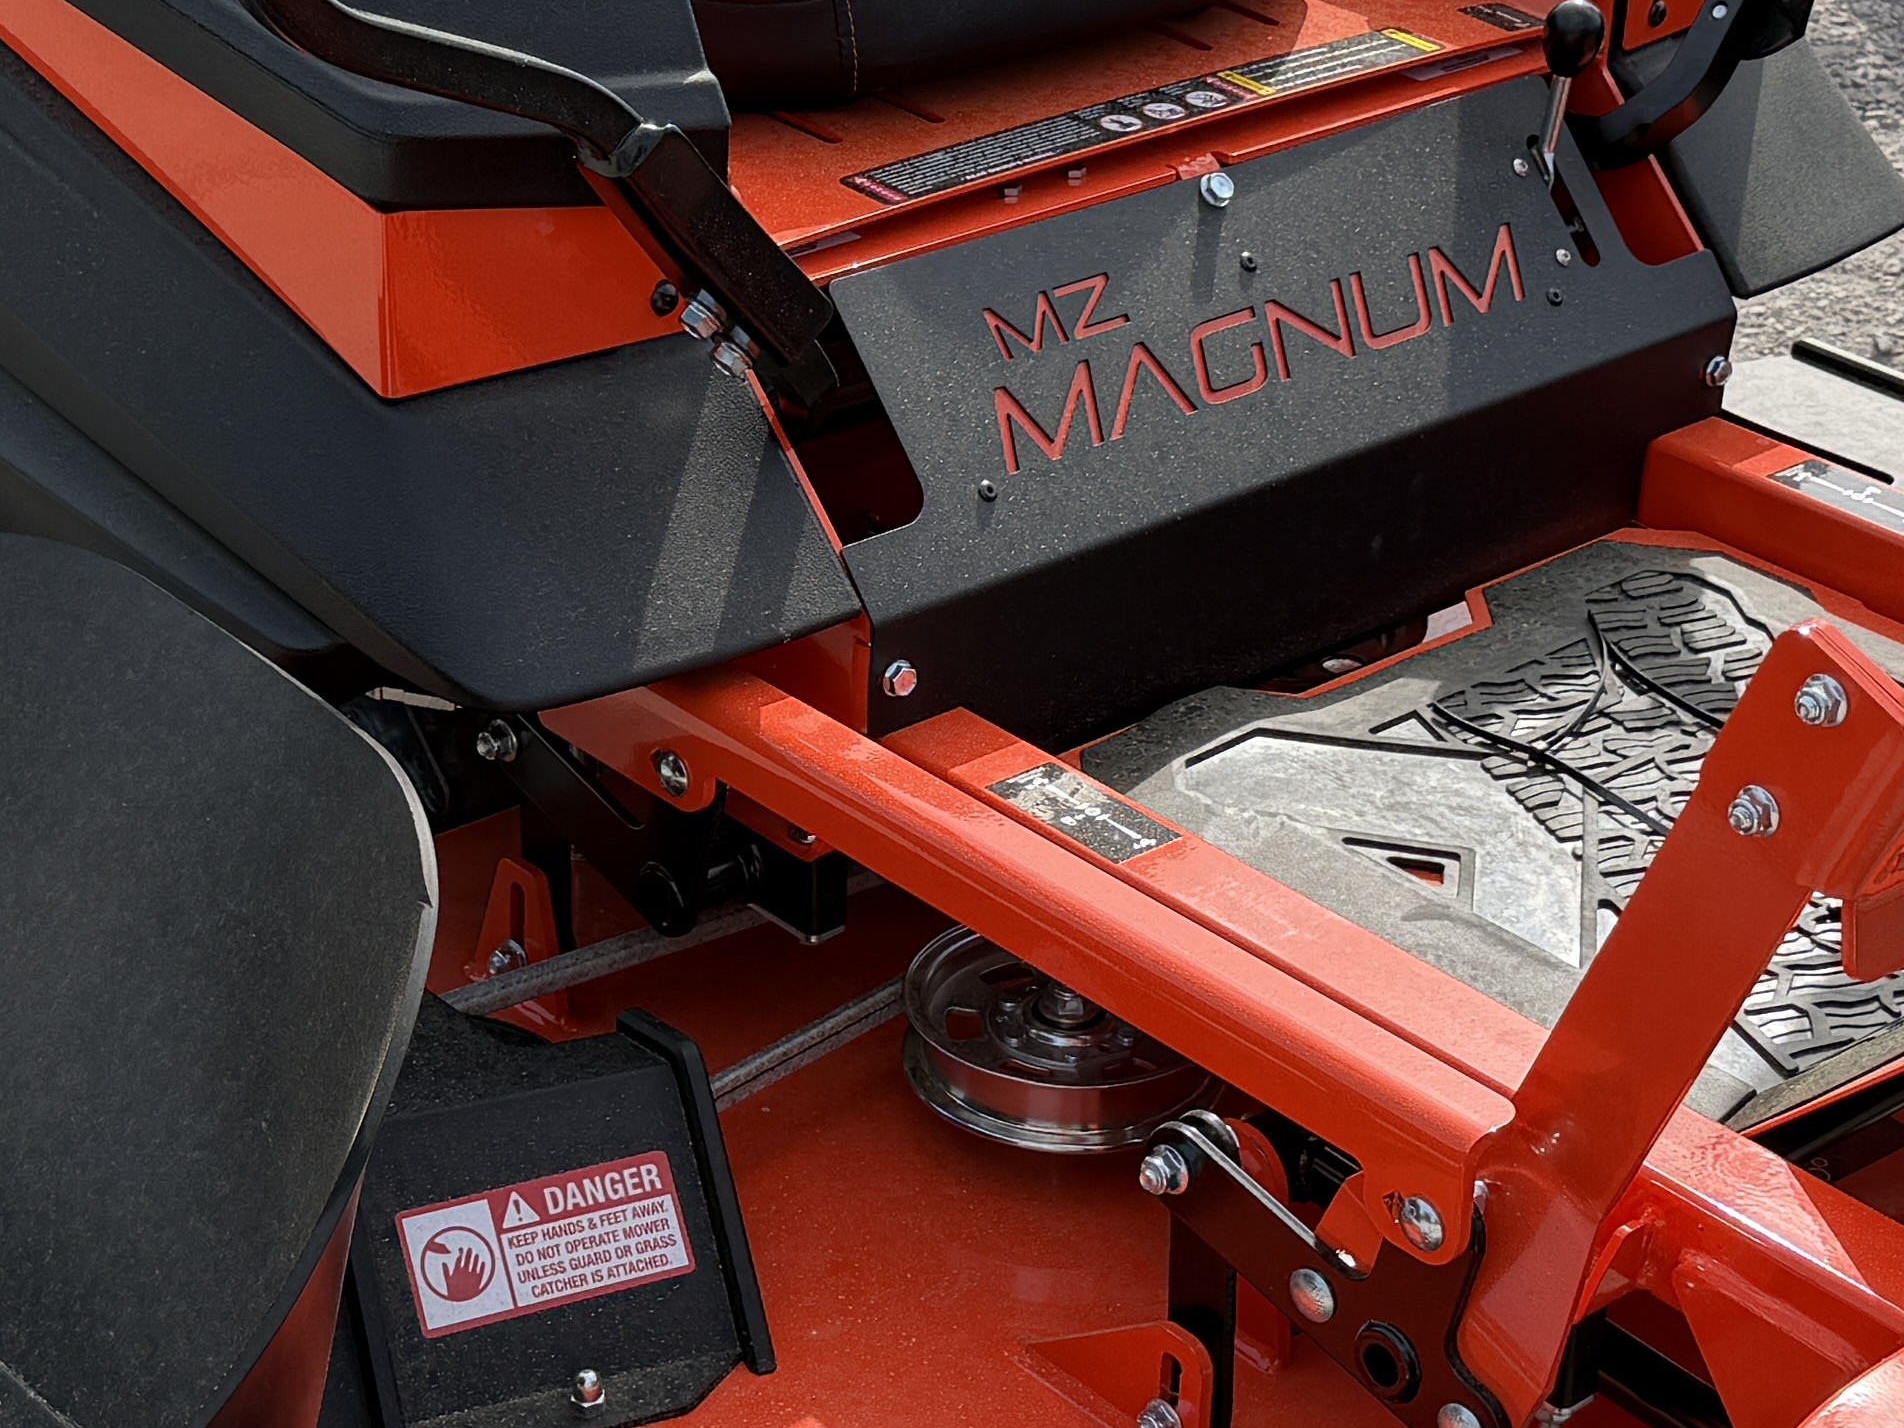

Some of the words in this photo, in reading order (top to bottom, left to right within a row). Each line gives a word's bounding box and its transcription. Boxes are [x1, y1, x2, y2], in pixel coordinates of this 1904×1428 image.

[983, 272, 1131, 362] MZ
[994, 223, 1526, 475] MAGNUM
[543, 1163, 662, 1215] DANGER
[507, 1230, 538, 1250] KEEP
[542, 1219, 585, 1241] HANDS
[587, 1217, 597, 1230] &
[599, 1208, 628, 1227] FEET
[515, 1250, 534, 1266] DO
[537, 1243, 561, 1261] NOT
[565, 1231, 621, 1254] OPERATE
[623, 1217, 670, 1239] MOWER
[517, 1262, 566, 1284] UNLESS
[569, 1250, 613, 1271] GUARD
[616, 1245, 633, 1260] OR
[636, 1234, 678, 1254] GRASS
[531, 1273, 589, 1298] CATCHER
[590, 1269, 604, 1284] IS
